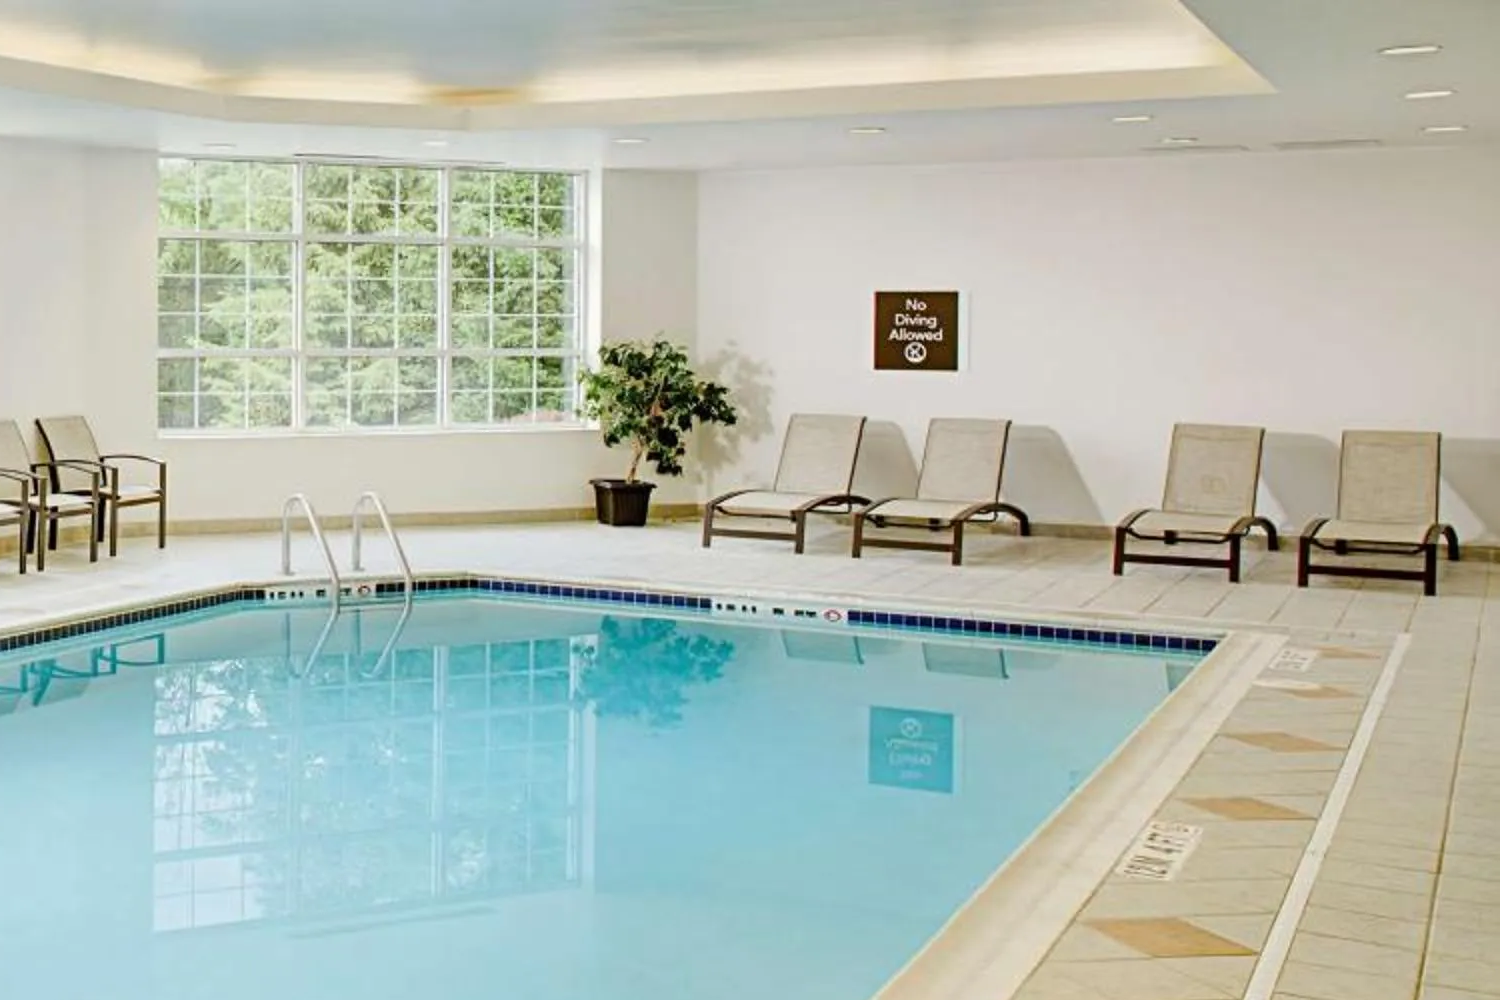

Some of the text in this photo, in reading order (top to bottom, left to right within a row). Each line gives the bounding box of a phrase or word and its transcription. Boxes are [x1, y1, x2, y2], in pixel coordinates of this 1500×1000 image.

[905, 298, 927, 311] No
[895, 313, 937, 329] Diving
[888, 328, 943, 341] Allowed
